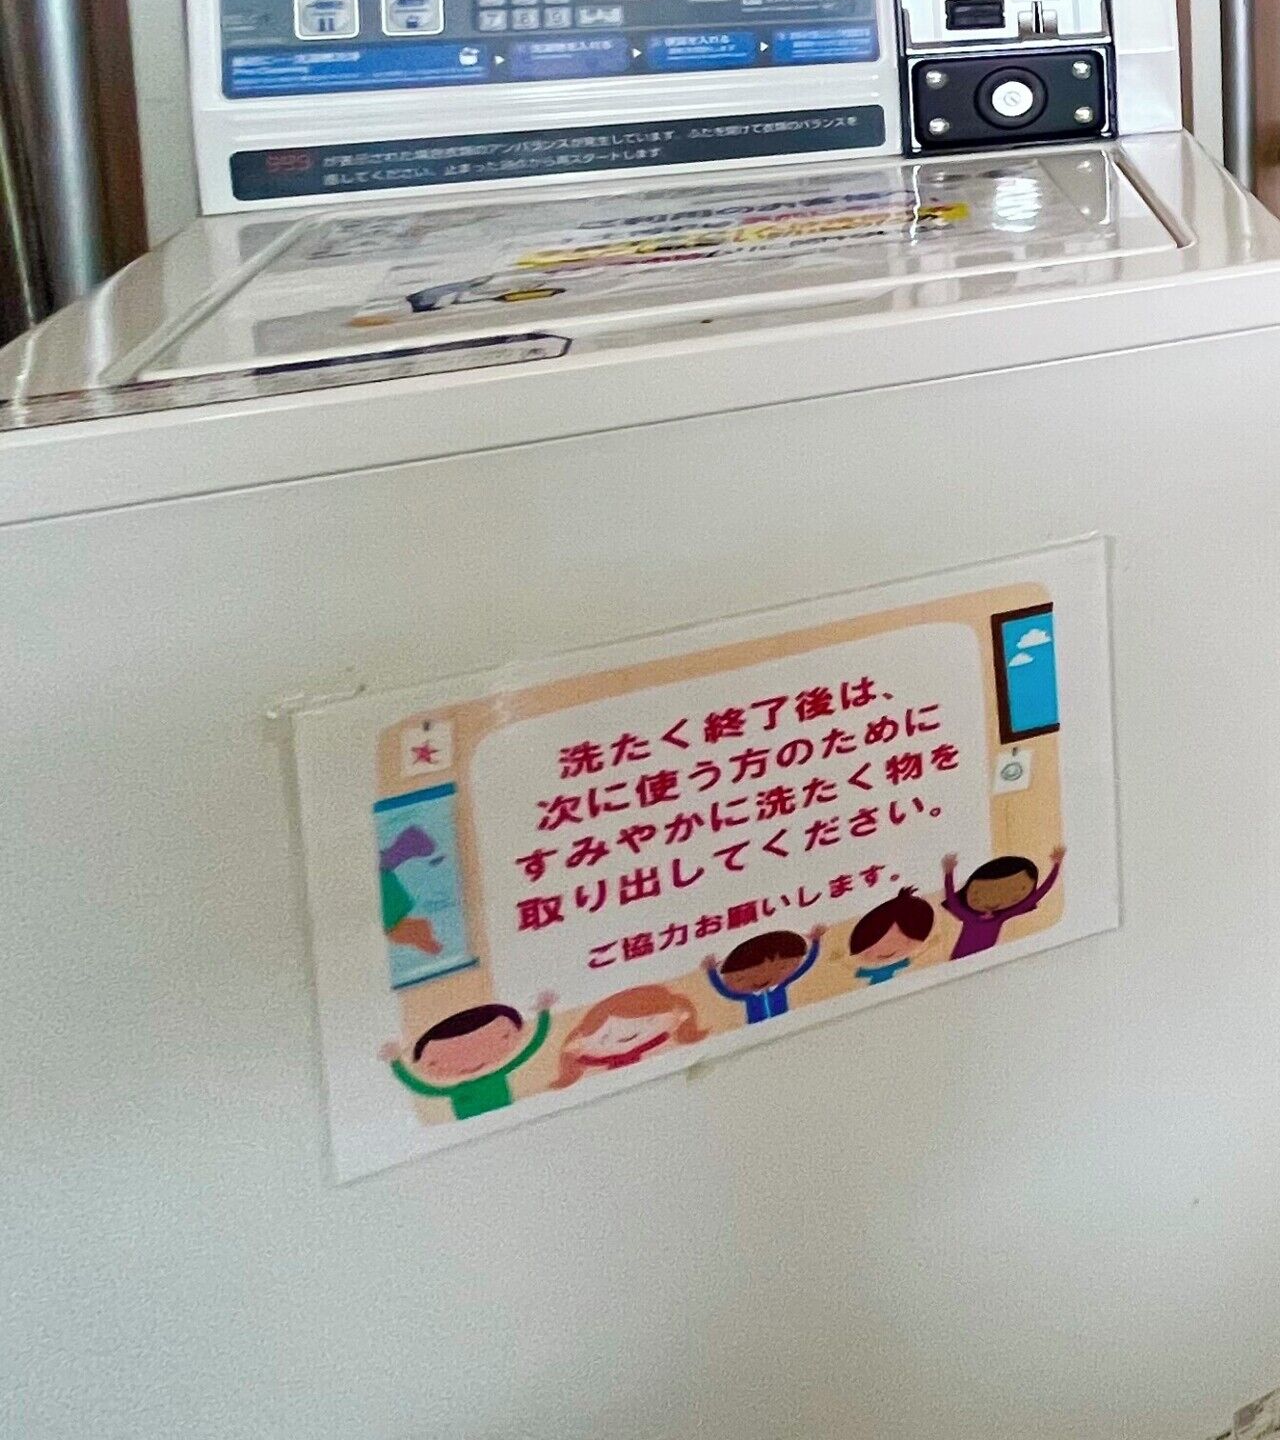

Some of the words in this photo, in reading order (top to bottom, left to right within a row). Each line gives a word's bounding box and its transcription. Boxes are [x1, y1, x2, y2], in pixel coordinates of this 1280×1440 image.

[536, 704, 943, 831] 次に使う方のために
[559, 675, 896, 777] 洗たく終了後は、
[515, 741, 962, 880] すみやかに洗たく物を
[516, 798, 943, 933] 取り出してください。
[587, 863, 904, 971] ご協力お願いします。
